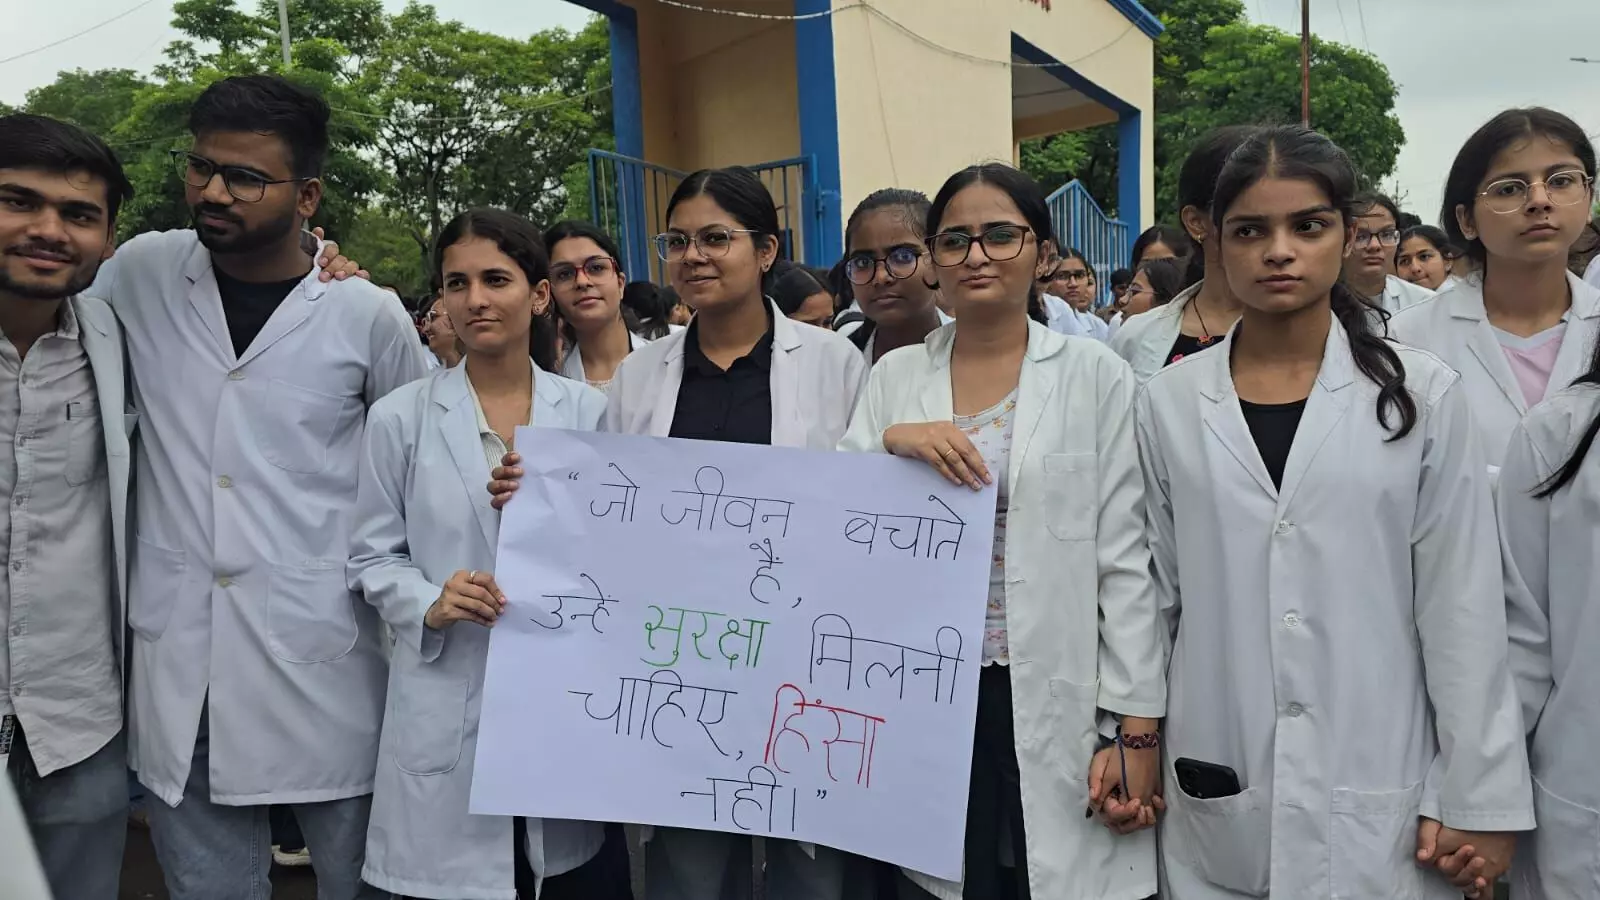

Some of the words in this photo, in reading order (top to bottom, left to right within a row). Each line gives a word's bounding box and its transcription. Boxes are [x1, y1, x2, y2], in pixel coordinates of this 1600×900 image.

[660, 465, 795, 538] जीवन
[844, 495, 967, 560] बचाते
[640, 605, 771, 670] सुरक्षा
[809, 613, 964, 704] मिलनी
[568, 669, 744, 761] चाहिए,
[764, 683, 886, 788] हिंसा
